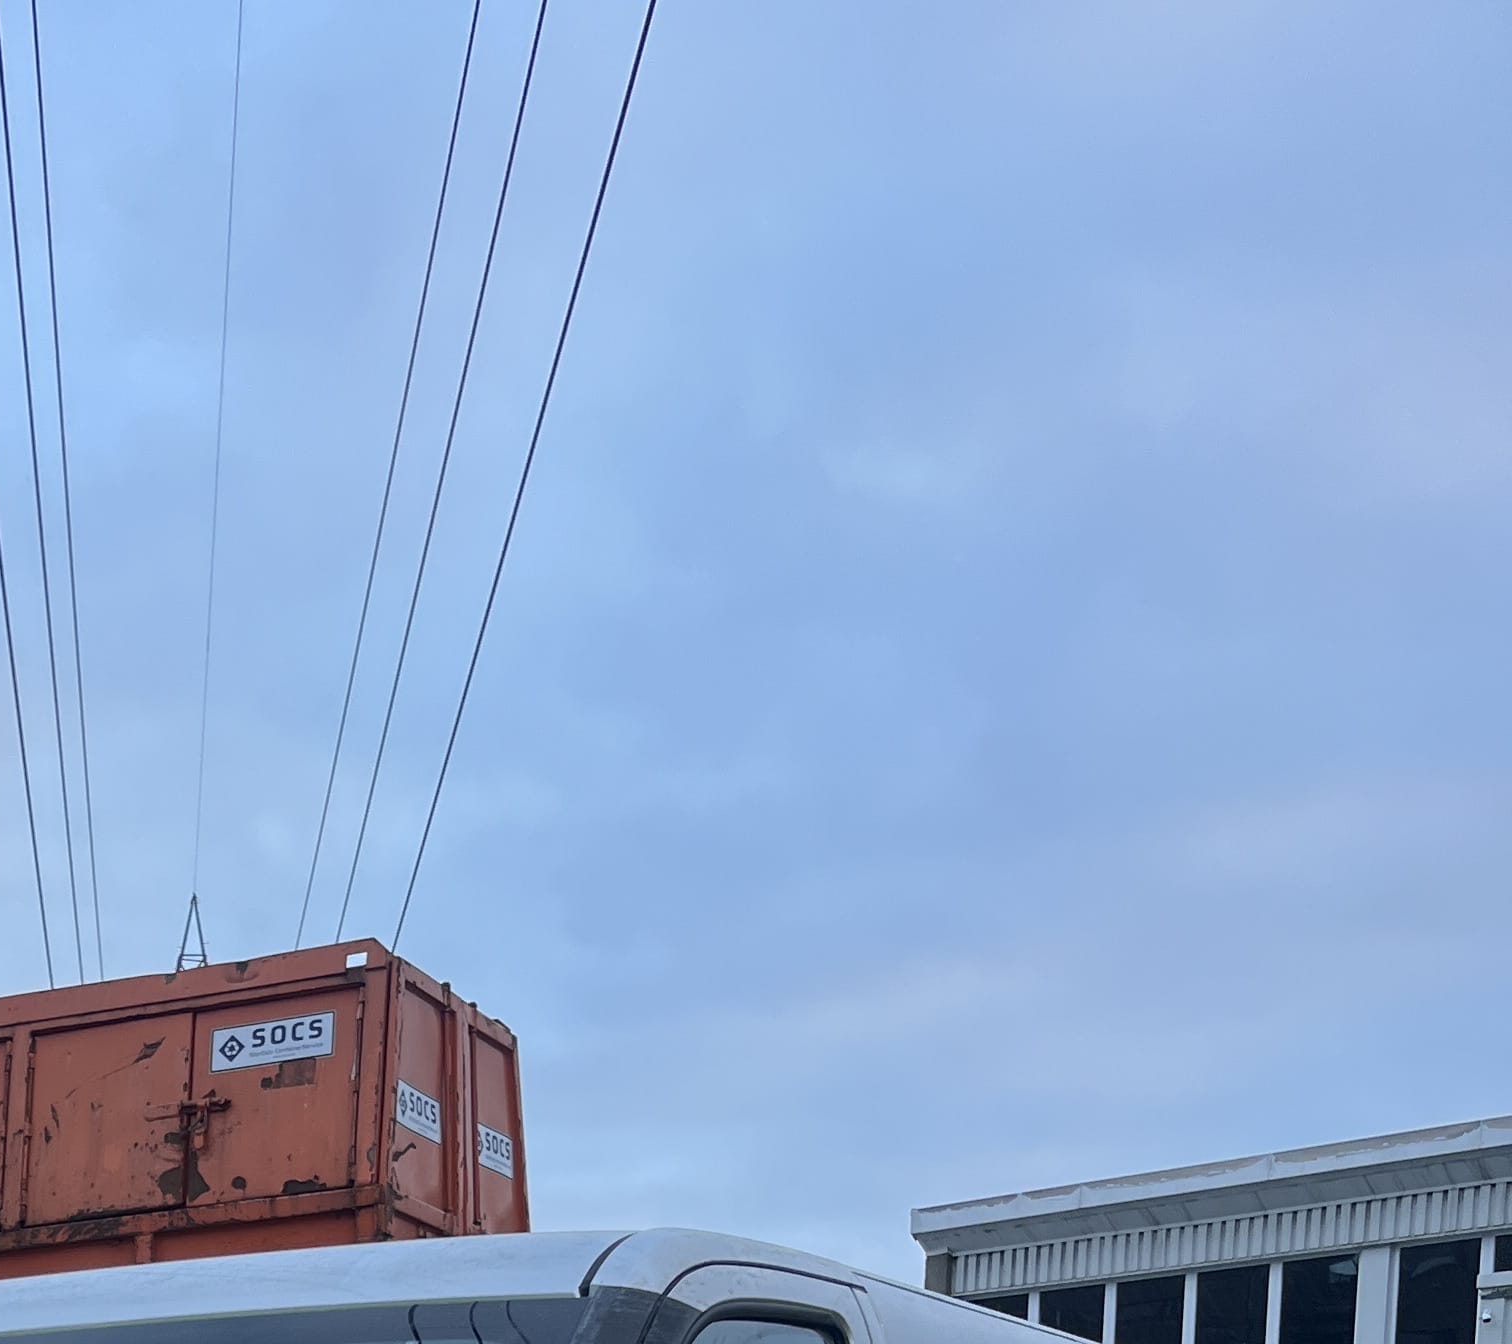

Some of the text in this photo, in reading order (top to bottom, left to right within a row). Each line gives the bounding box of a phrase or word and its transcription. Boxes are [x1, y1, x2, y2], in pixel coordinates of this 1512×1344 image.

[251, 1018, 323, 1049] SOCS
[409, 1091, 437, 1124] SOCS
[485, 1132, 511, 1160] SOCS
